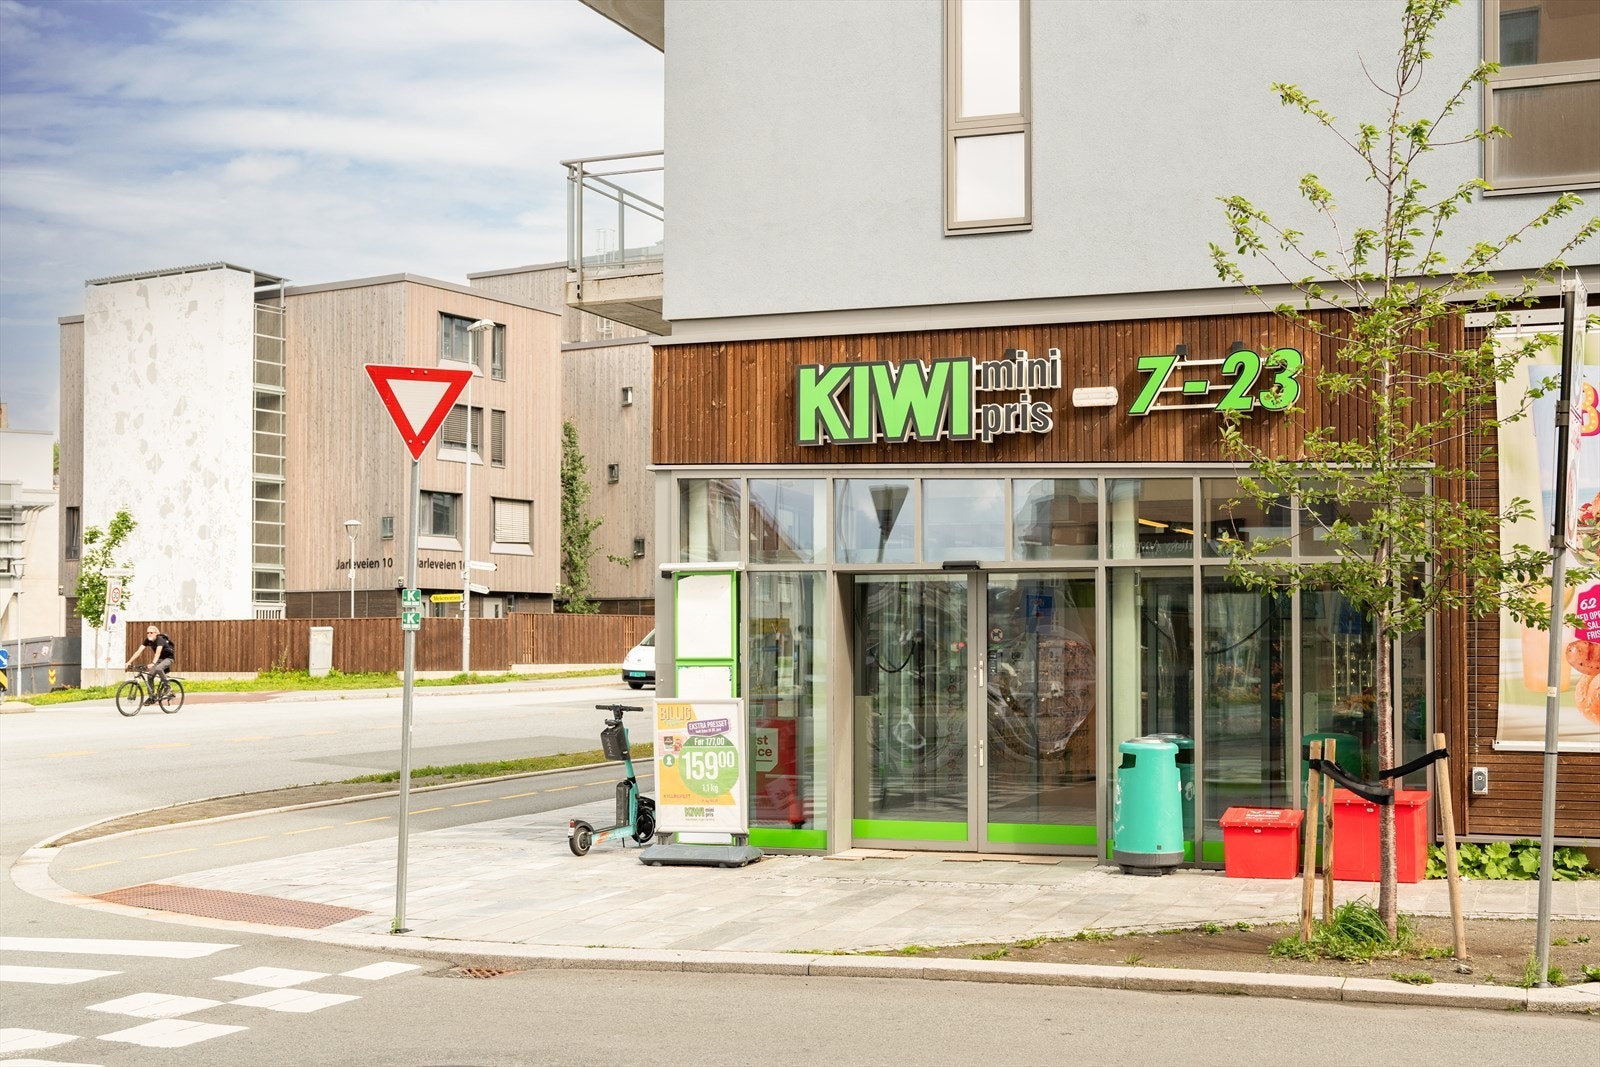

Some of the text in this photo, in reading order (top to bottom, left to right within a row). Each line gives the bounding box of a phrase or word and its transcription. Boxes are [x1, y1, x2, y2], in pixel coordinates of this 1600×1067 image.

[797, 348, 1061, 446] KIWI mini
[981, 393, 1053, 443] pris
[336, 557, 393, 570] Jarleveien 10
[660, 706, 692, 720] BILLIG
[688, 721, 706, 730] EKSTRA
[707, 719, 728, 728] PRESSET
[710, 783, 719, 794] kg
[684, 806, 705, 817] KIWI
